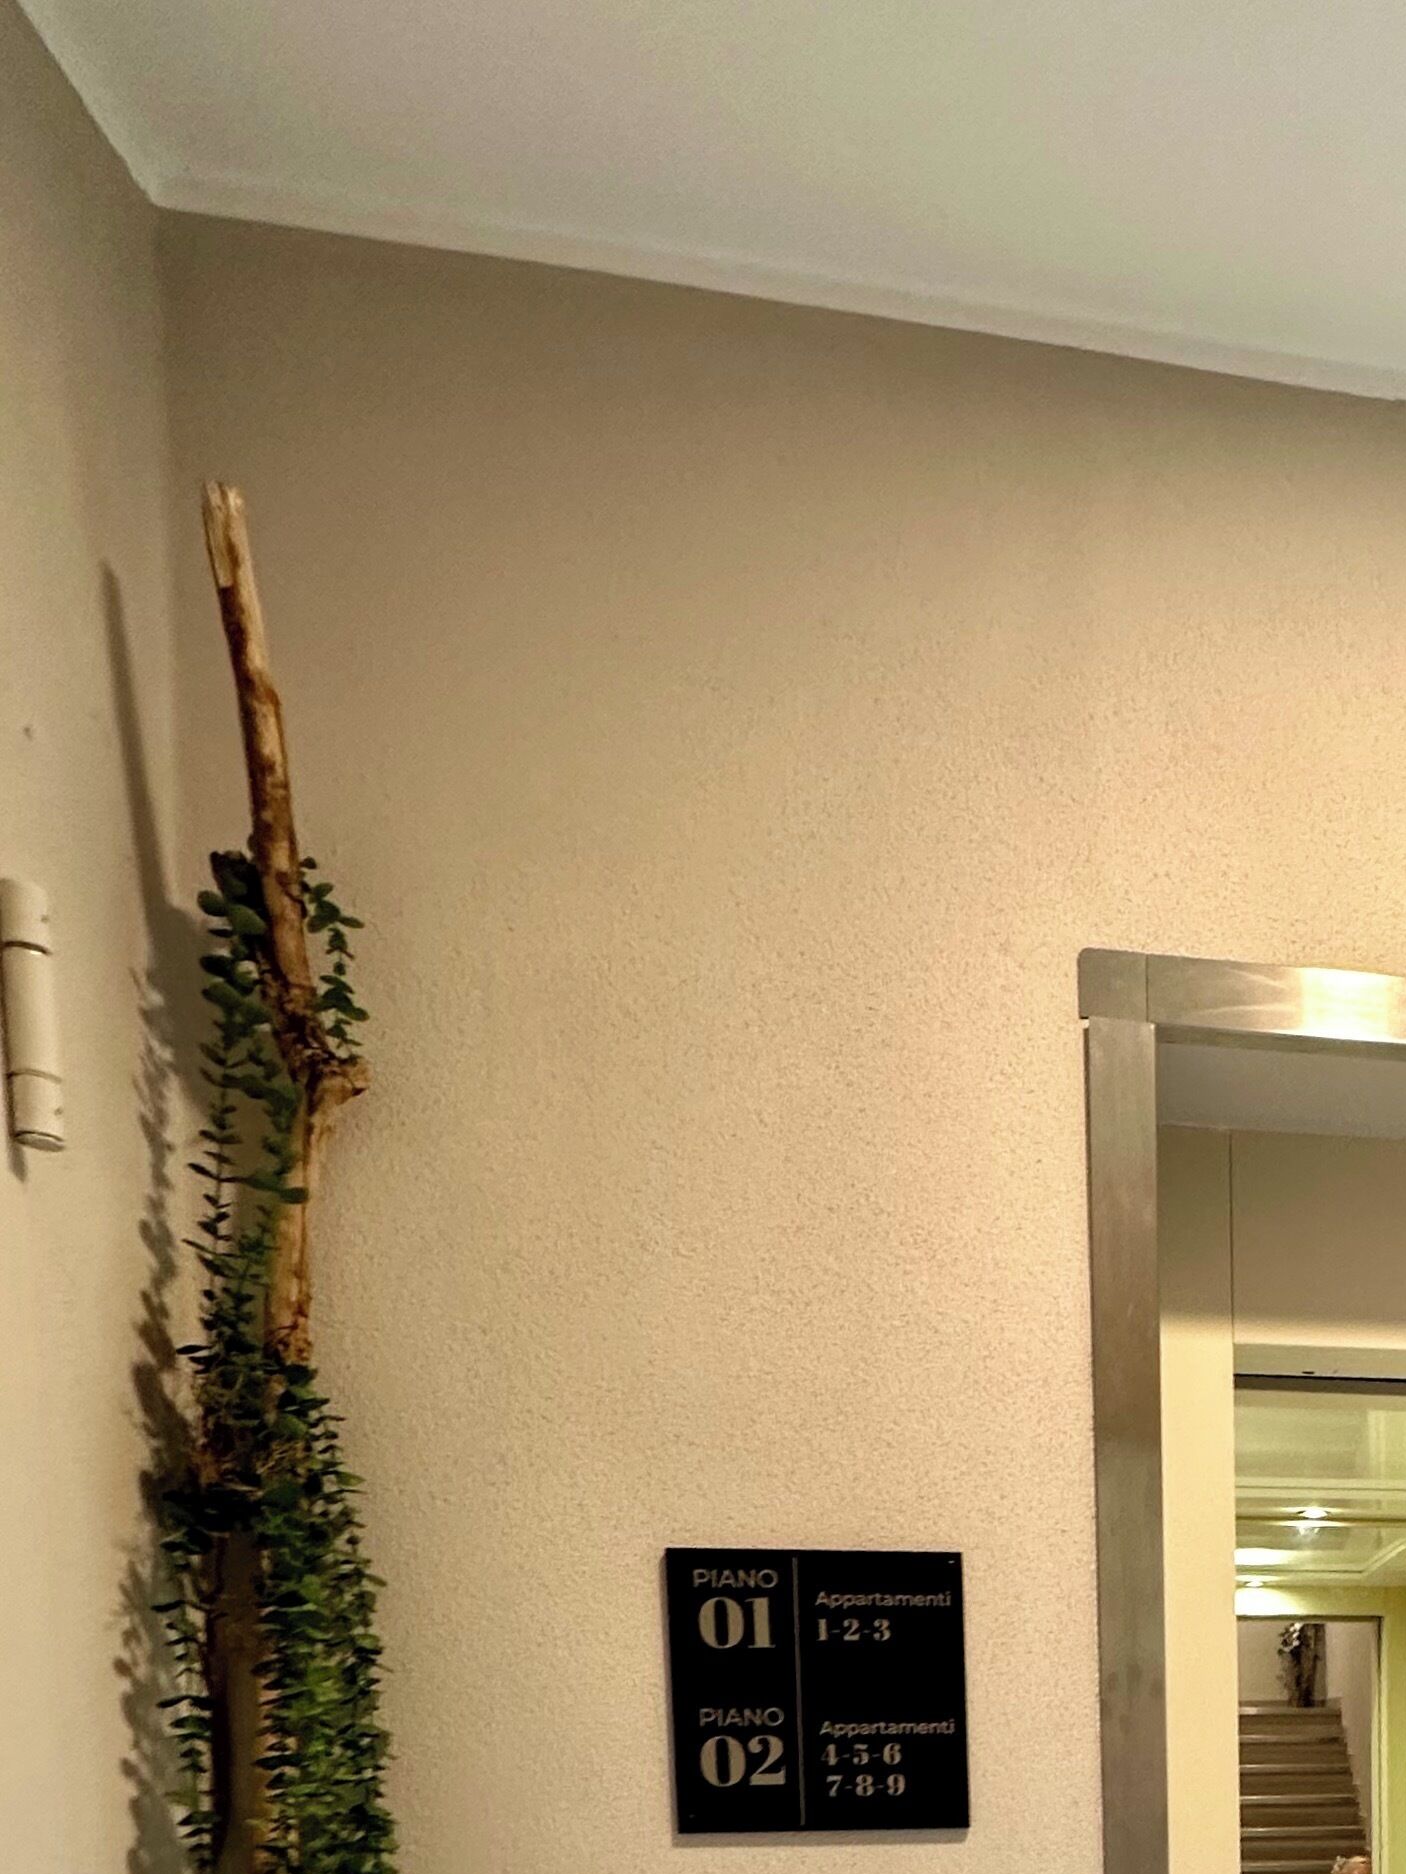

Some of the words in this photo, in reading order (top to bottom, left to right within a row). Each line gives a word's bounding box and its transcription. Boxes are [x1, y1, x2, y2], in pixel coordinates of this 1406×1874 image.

[692, 1568, 779, 1588] PIANO
[815, 1591, 951, 1608] Appartamenti
[698, 1597, 776, 1649] 01
[699, 1707, 785, 1727] PIANO
[819, 1718, 955, 1738] Appartamenti
[700, 1734, 787, 1788] 02
